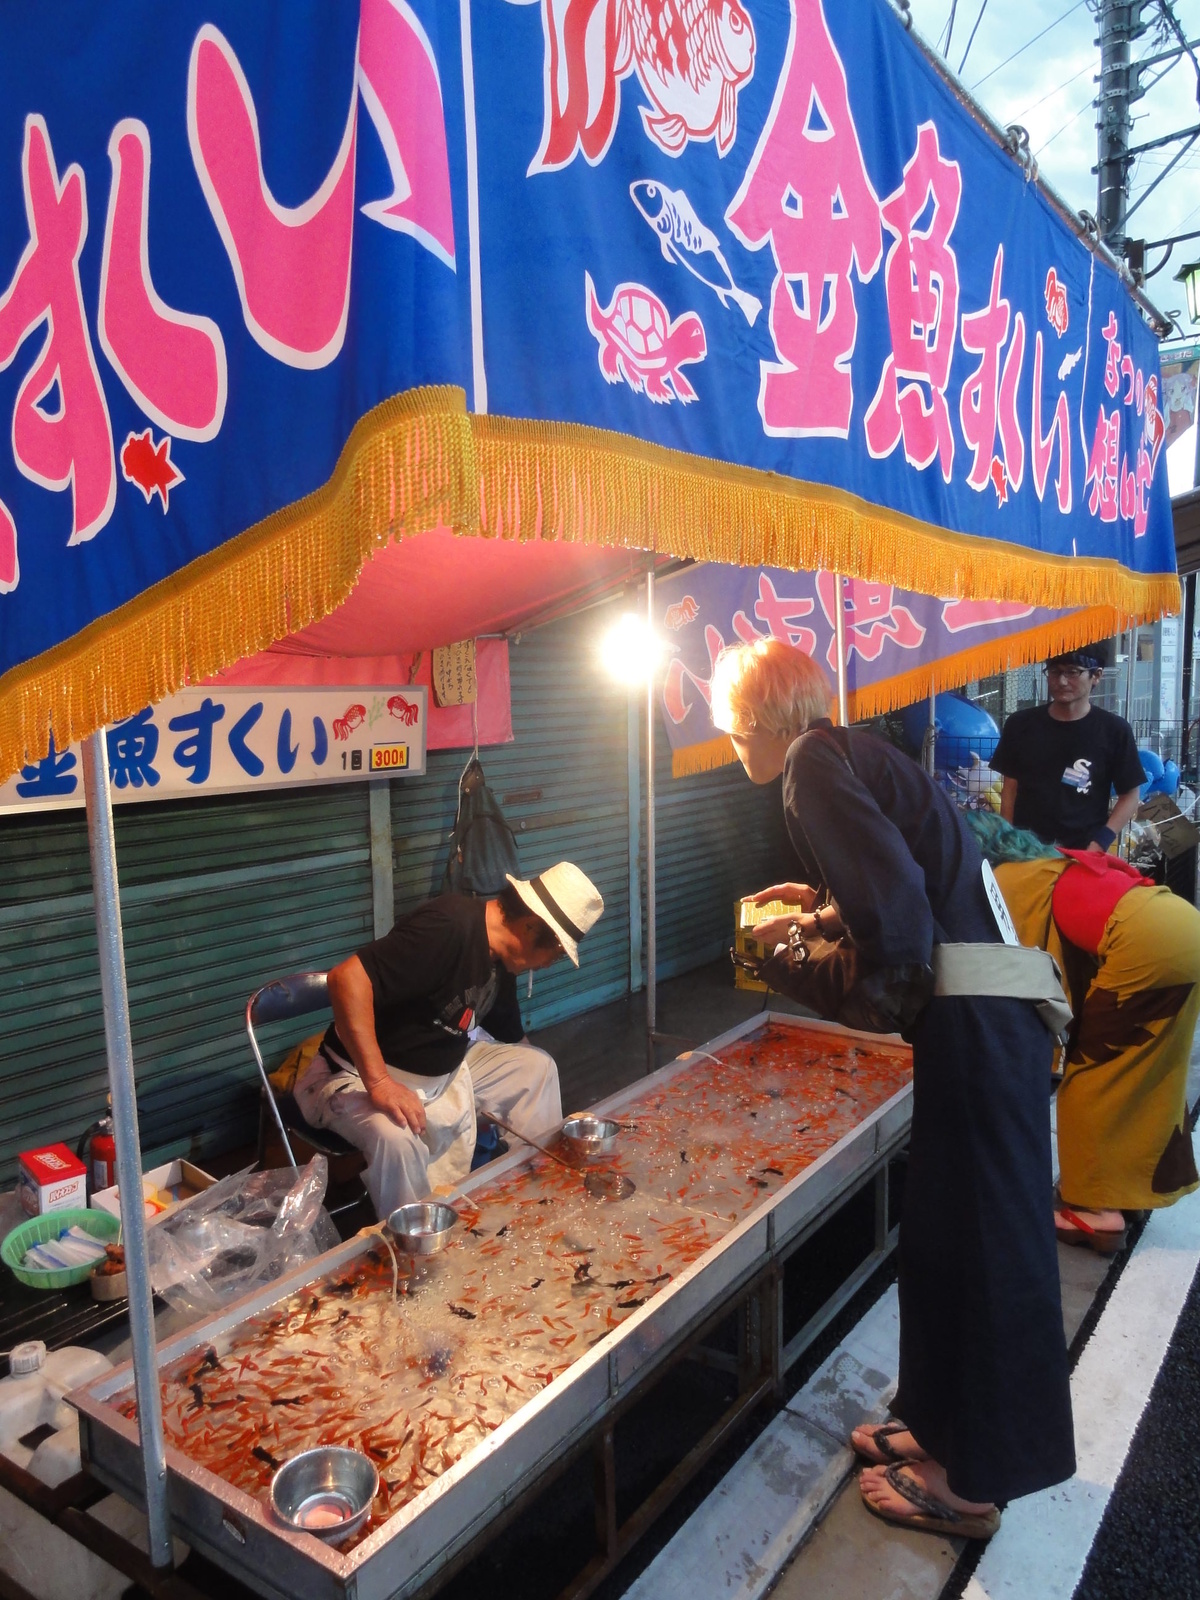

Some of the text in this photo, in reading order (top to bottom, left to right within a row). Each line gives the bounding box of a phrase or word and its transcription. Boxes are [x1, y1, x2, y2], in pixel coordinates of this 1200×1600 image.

[0, 0, 457, 594] すくい
[724, 0, 1073, 515] 金魚すくい
[1087, 403, 1152, 538] 想い出
